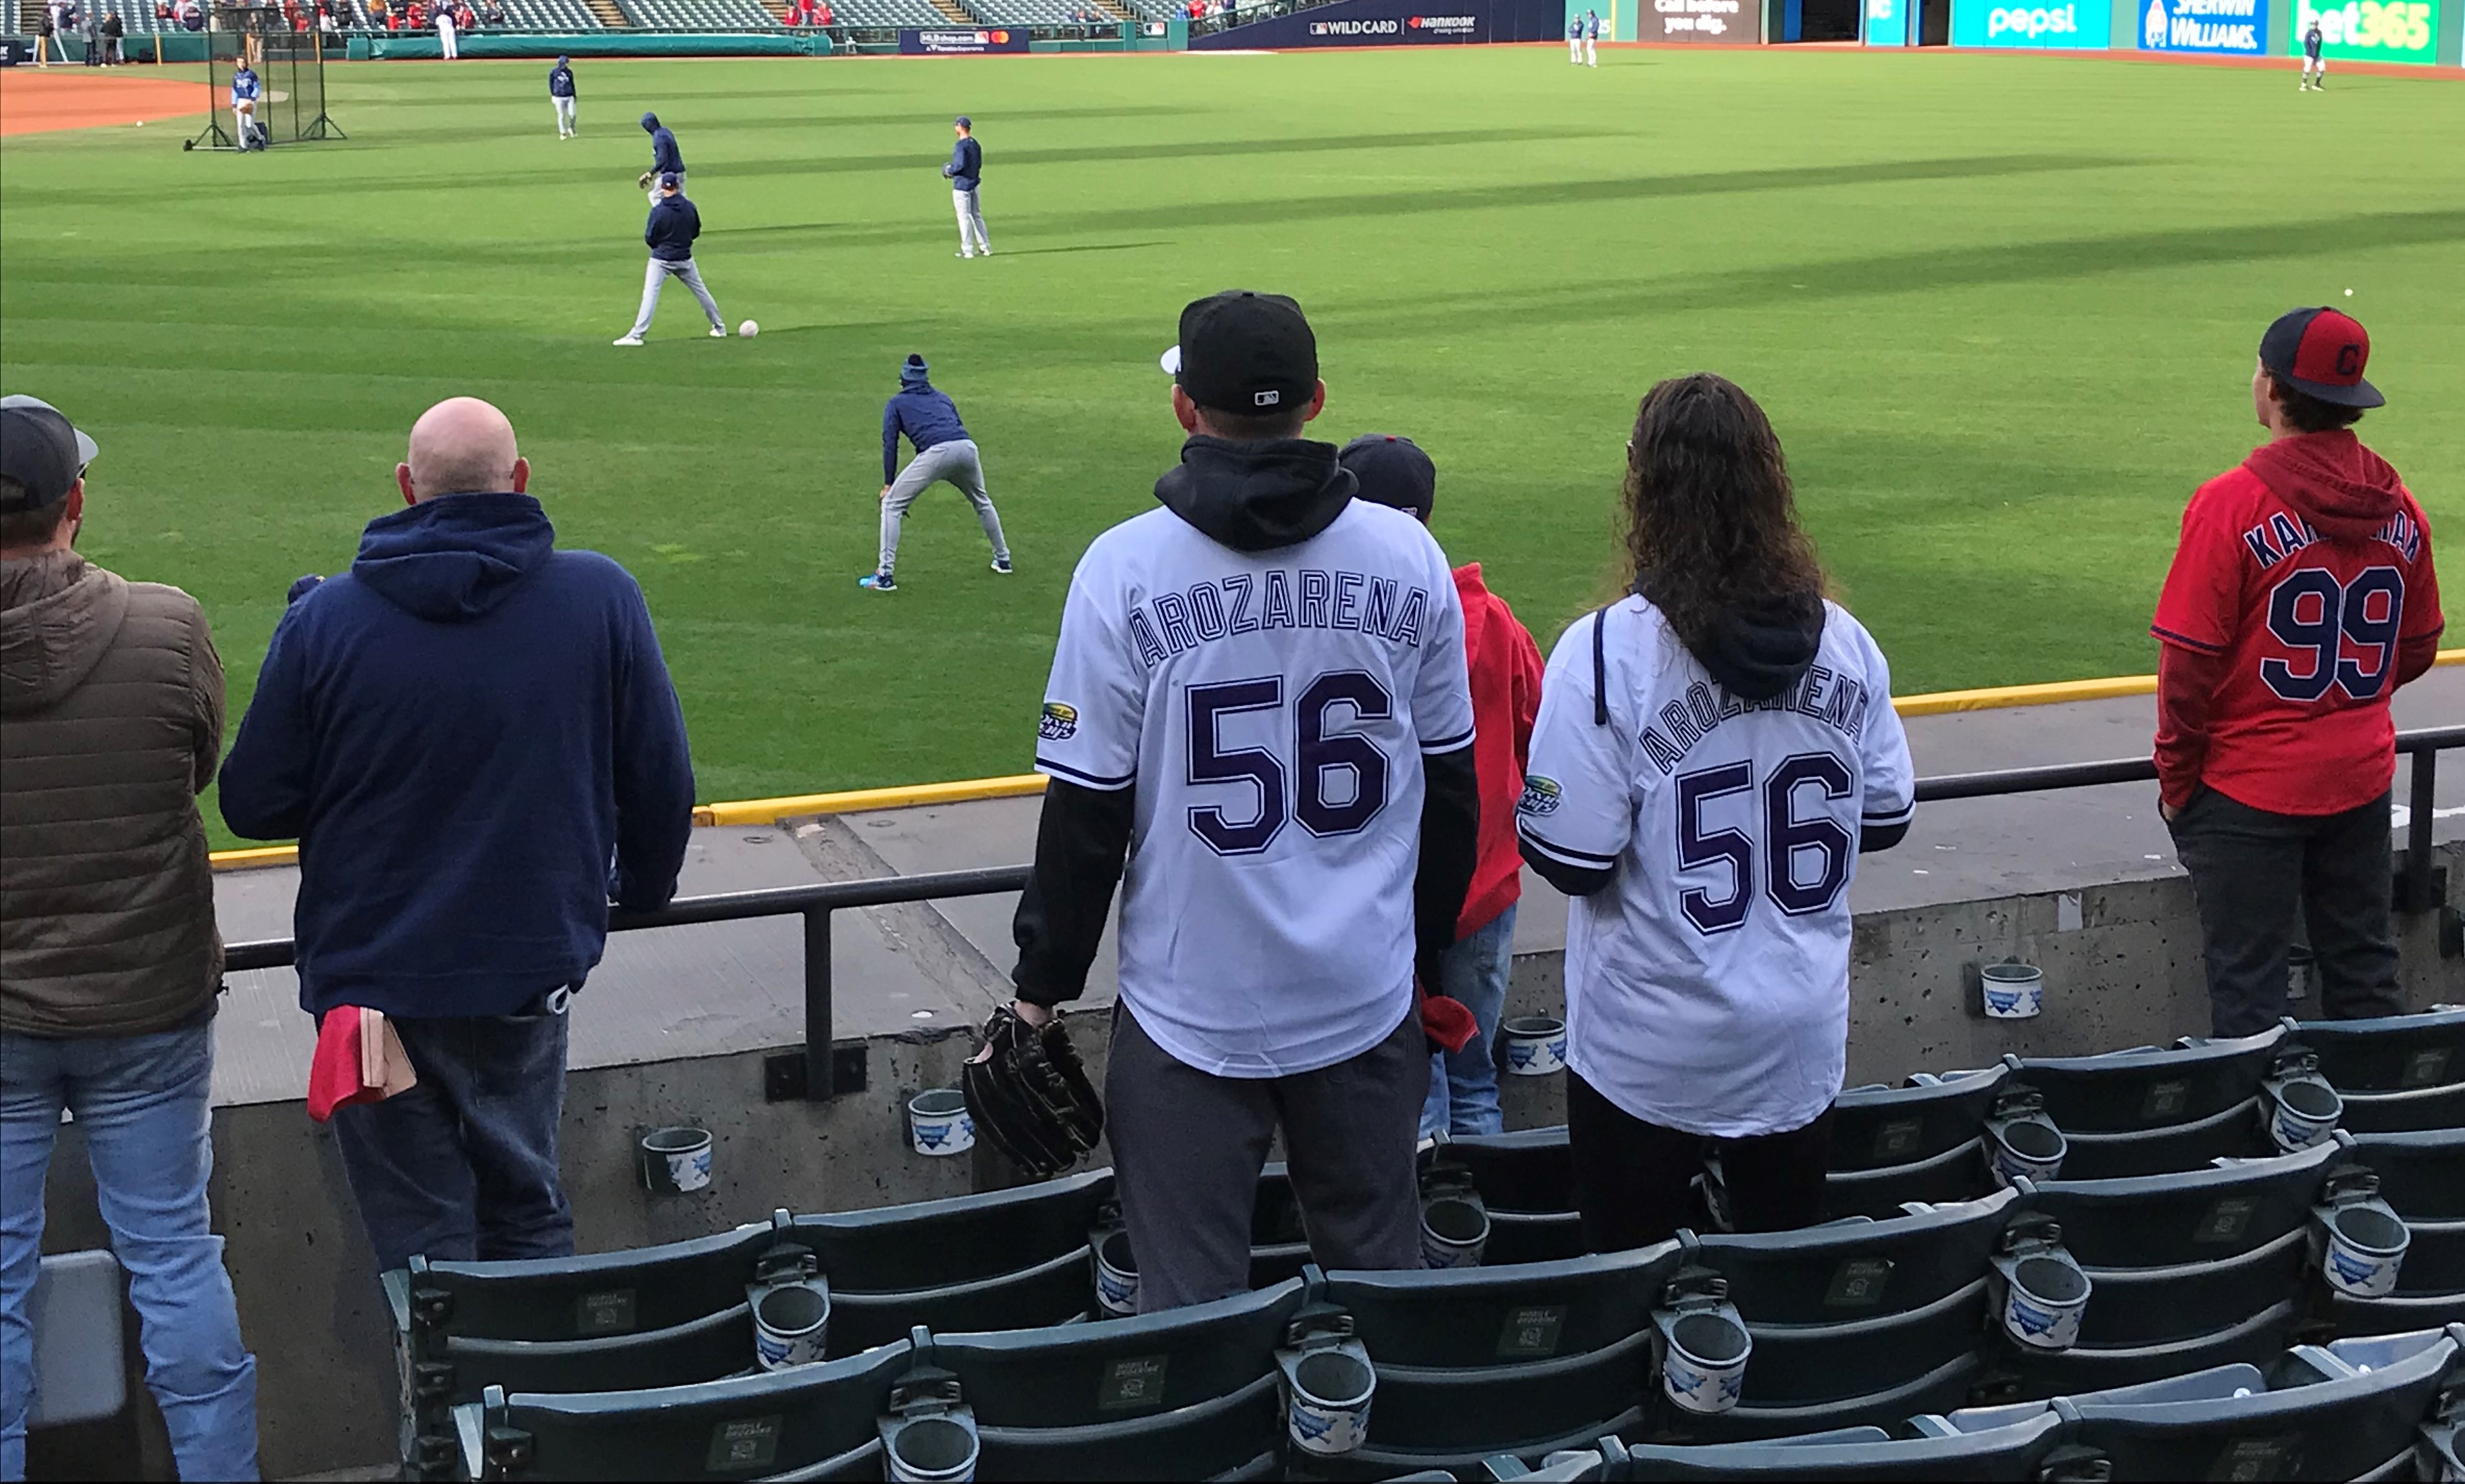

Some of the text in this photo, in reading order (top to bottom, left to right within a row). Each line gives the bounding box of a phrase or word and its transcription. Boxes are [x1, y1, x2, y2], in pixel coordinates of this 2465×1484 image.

[1655, 0, 1739, 12] Call before
[1665, 17, 1693, 33] you
[1988, 4, 2077, 38] pepsi
[2296, 0, 2430, 49] bet365
[1328, 21, 1397, 34] WILD CARD
[2336, 344, 2360, 375] C
[1129, 570, 1428, 668] AROZARENA
[2259, 566, 2404, 701] 99
[1184, 669, 1393, 857] 56
[1675, 751, 1853, 936] 56
